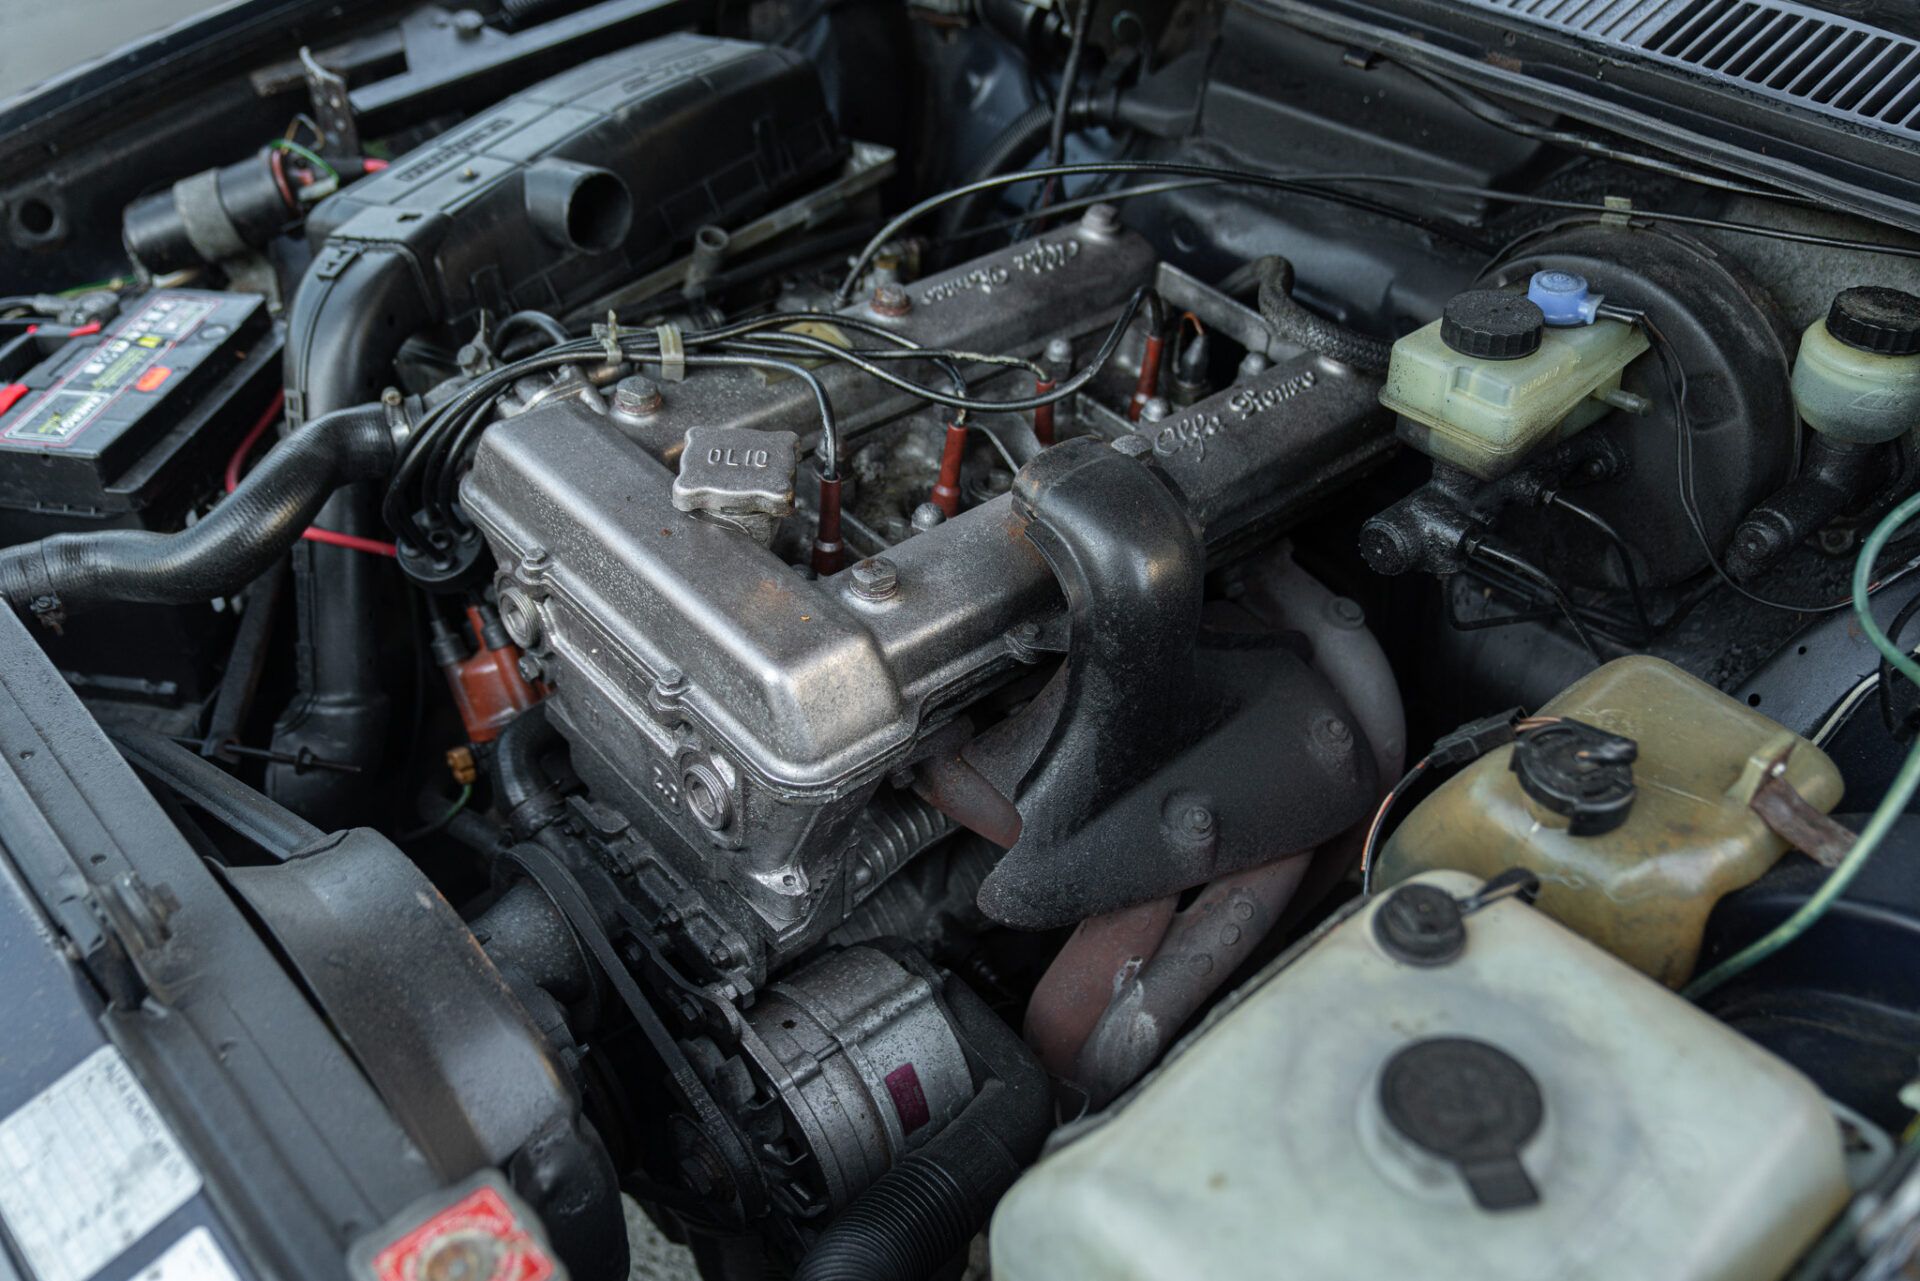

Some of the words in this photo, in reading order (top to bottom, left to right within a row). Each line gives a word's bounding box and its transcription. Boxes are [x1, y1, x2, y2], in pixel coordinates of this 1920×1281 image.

[1154, 413, 1224, 464] Alfa
[1229, 371, 1317, 421] Romeo
[707, 447, 769, 468] OLIO
